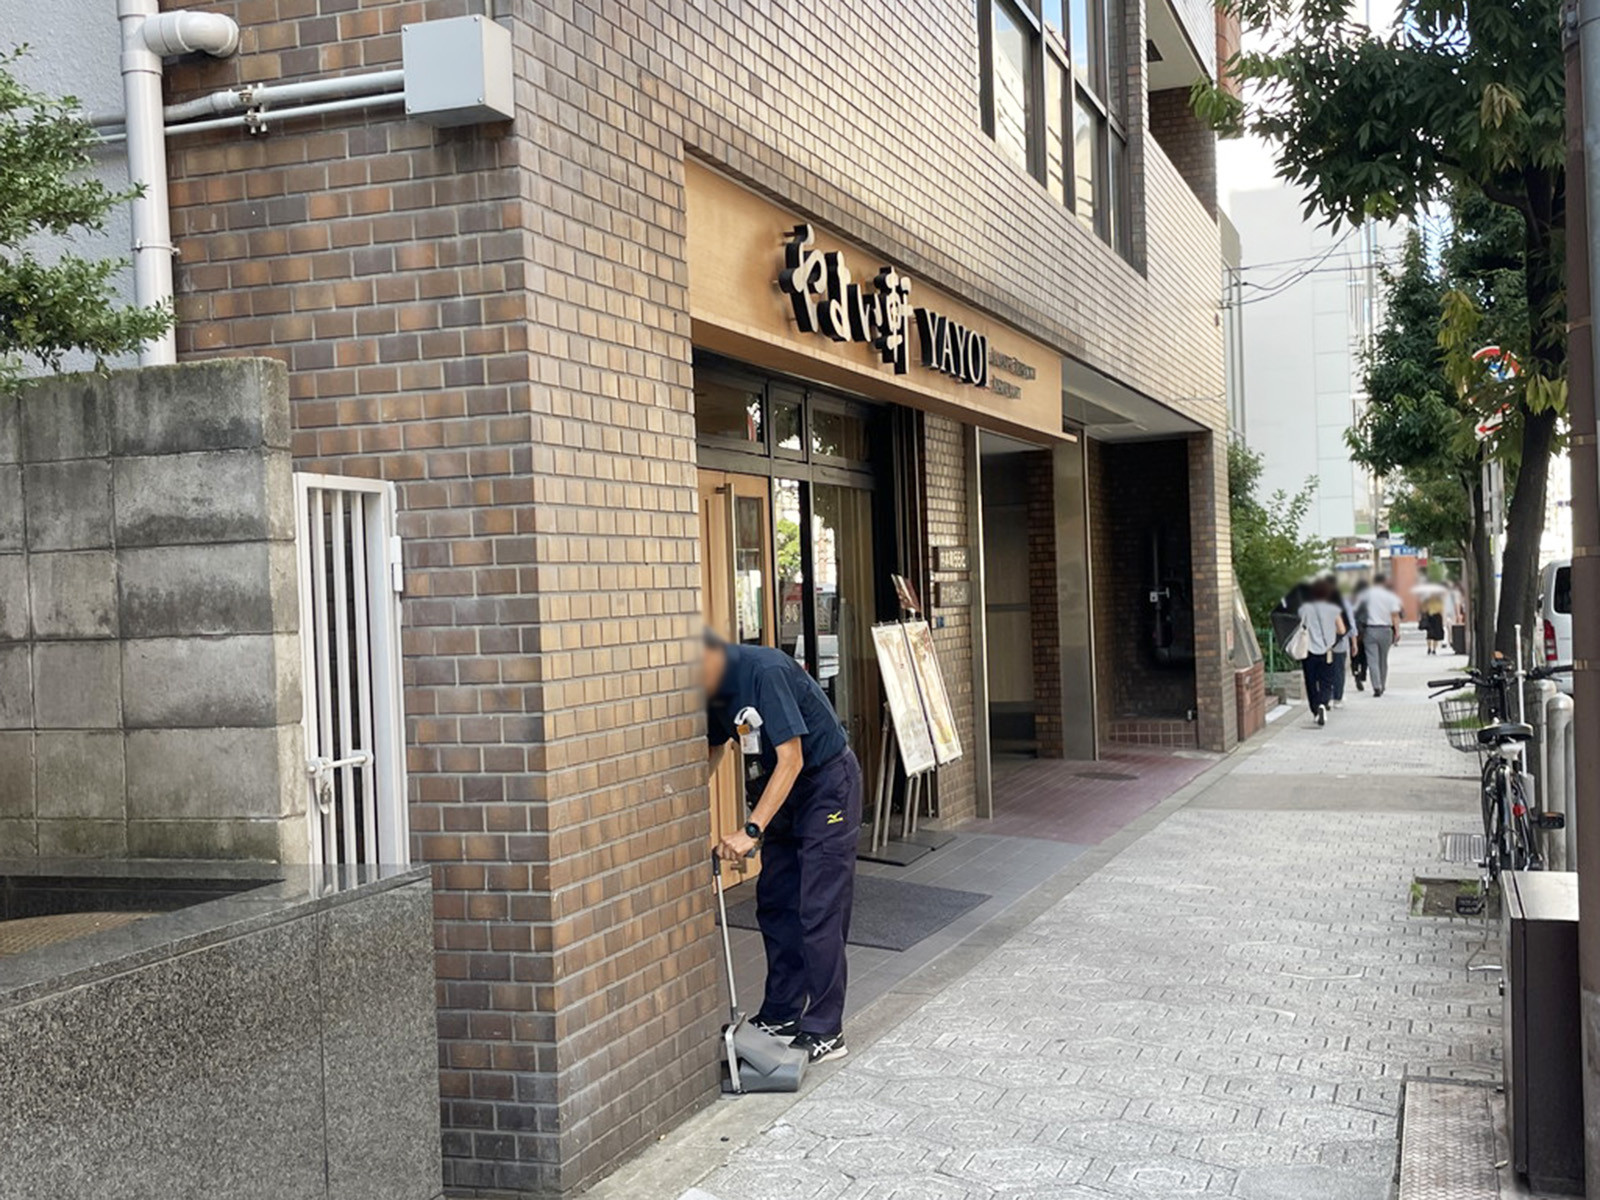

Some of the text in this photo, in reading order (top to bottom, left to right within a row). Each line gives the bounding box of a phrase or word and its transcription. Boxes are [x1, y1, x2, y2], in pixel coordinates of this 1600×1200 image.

[781, 223, 989, 387] やよい軒 YAYOI
